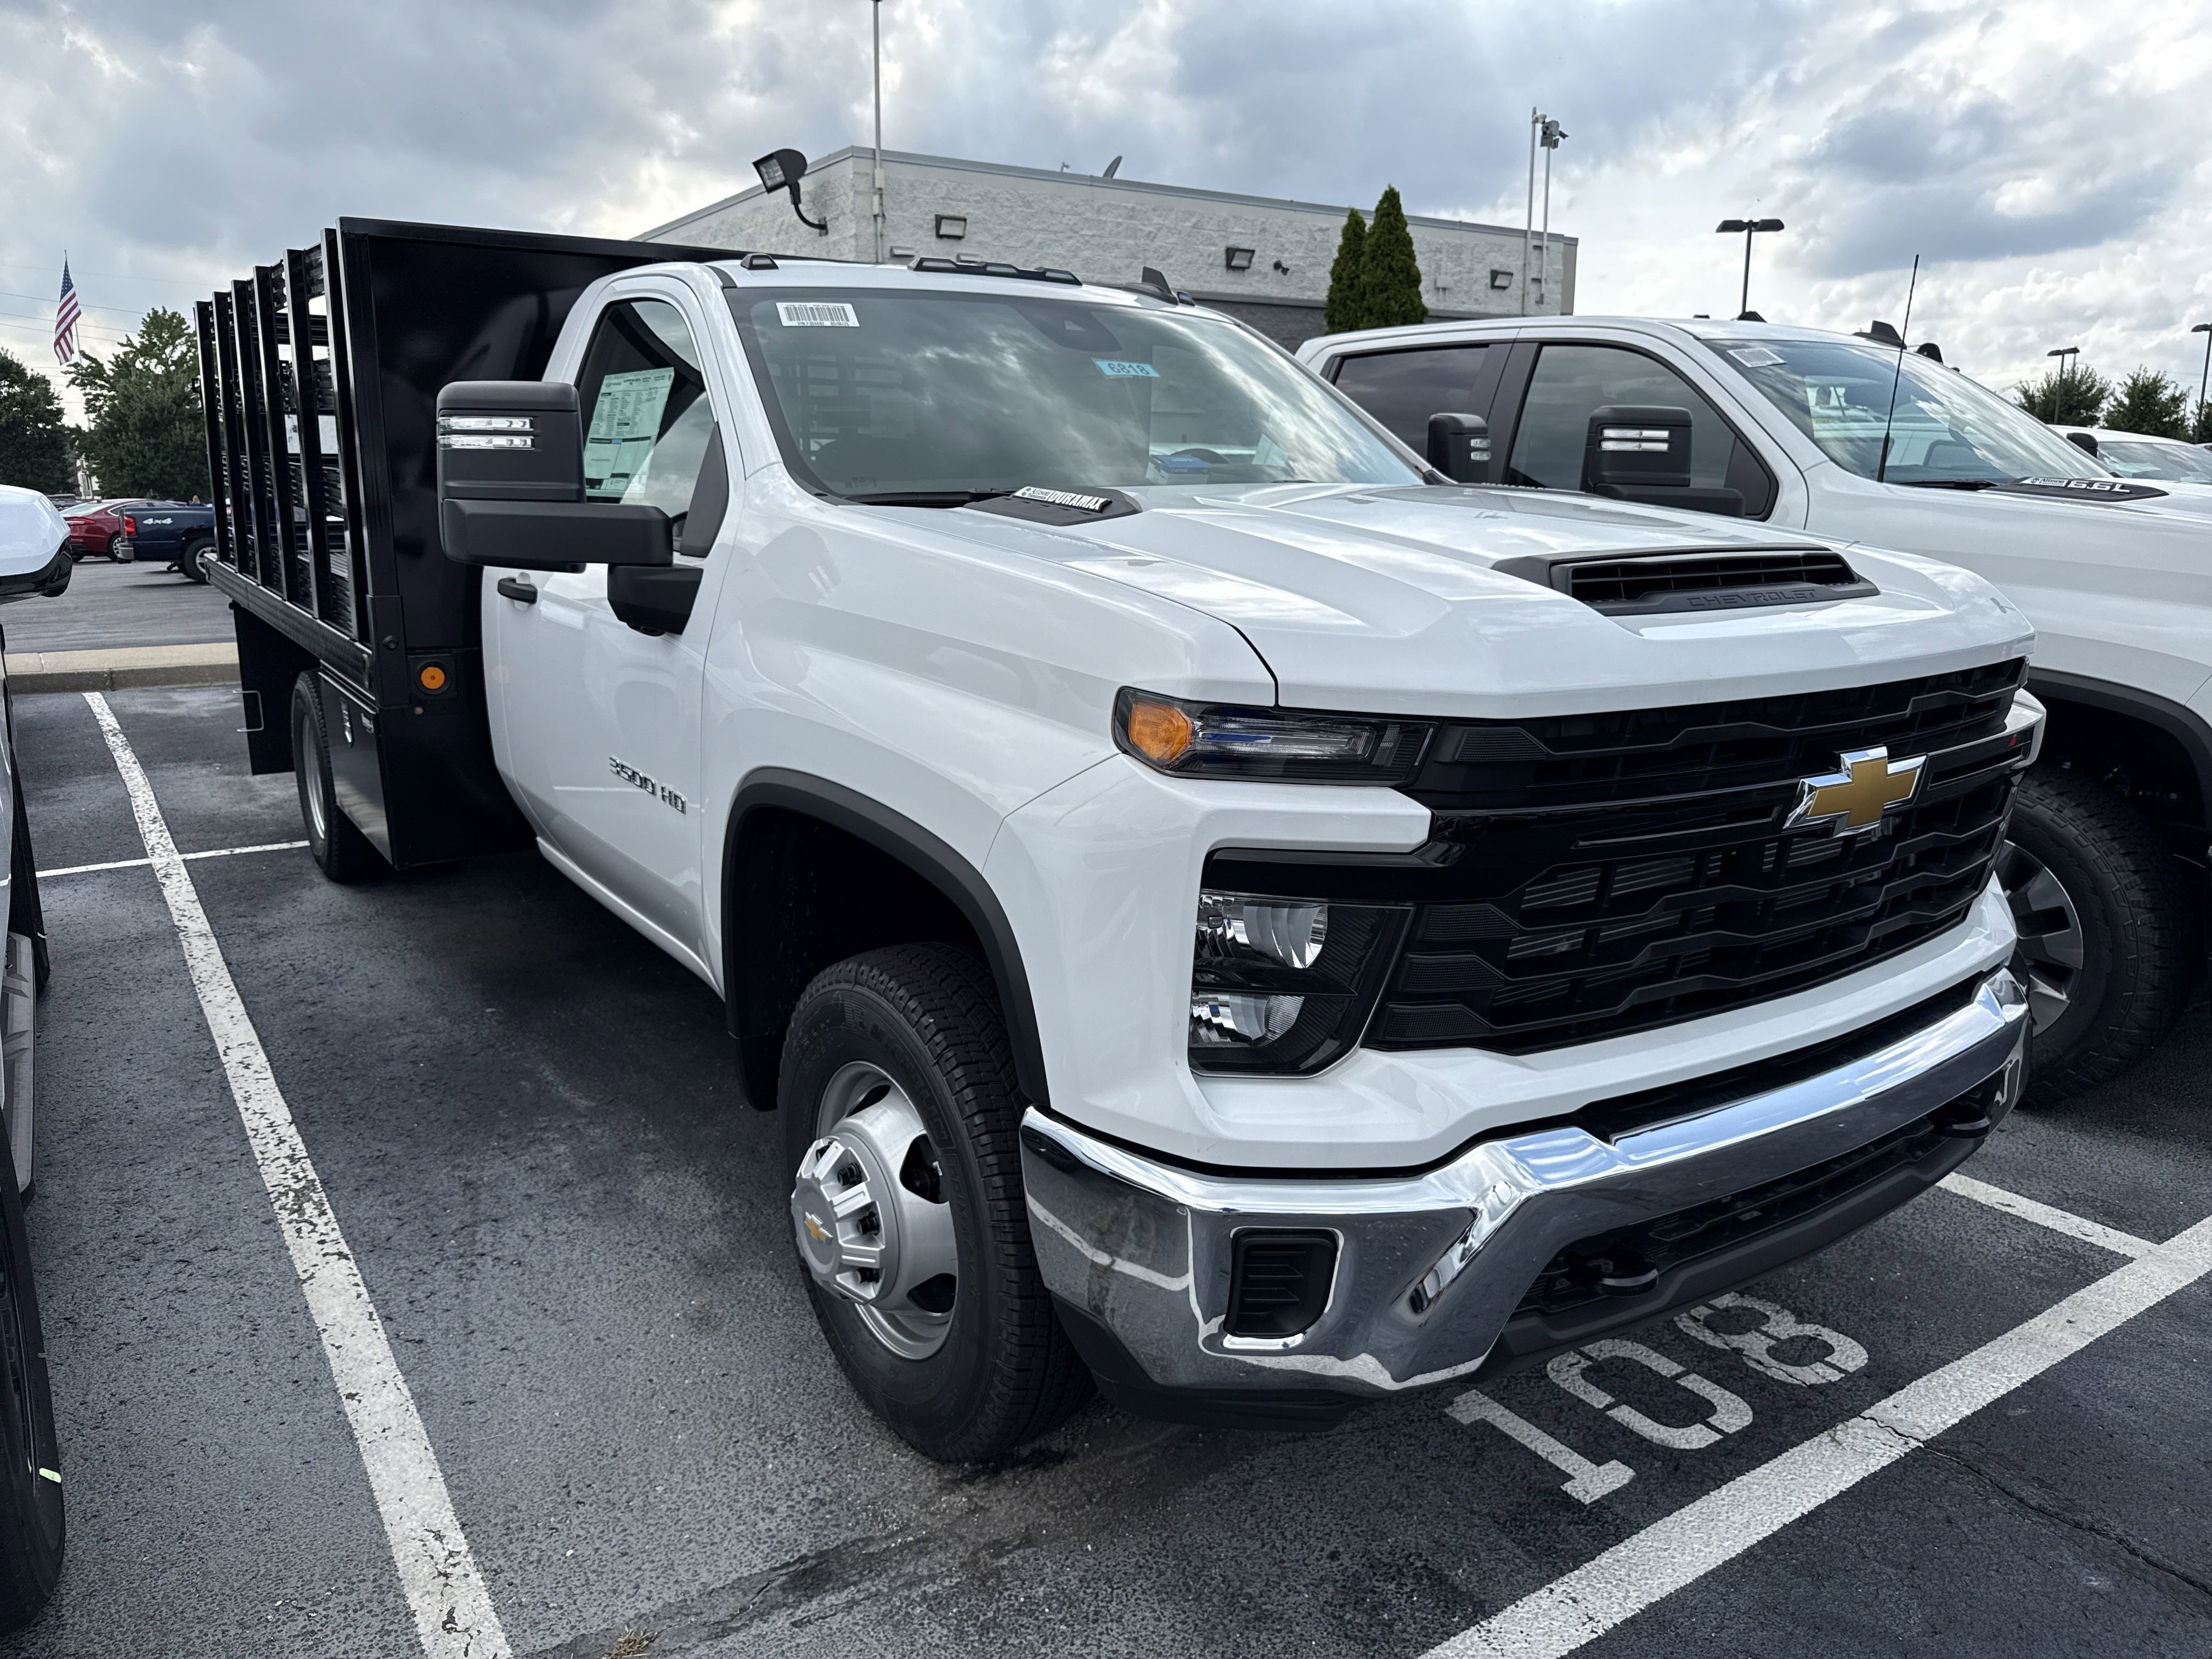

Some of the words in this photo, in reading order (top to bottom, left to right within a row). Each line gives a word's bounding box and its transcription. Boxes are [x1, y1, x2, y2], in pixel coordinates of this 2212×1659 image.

[1108, 363, 1150, 375] 6818
[2068, 481, 2130, 493] 6.6L
[1047, 490, 1107, 510] DURAMAX
[1687, 589, 1815, 607] CHEVROLET
[609, 755, 657, 797] 3500
[661, 783, 687, 815] HD
[870, 1022, 948, 1141] MICHELIN
[1444, 1291, 1869, 1505] 108
